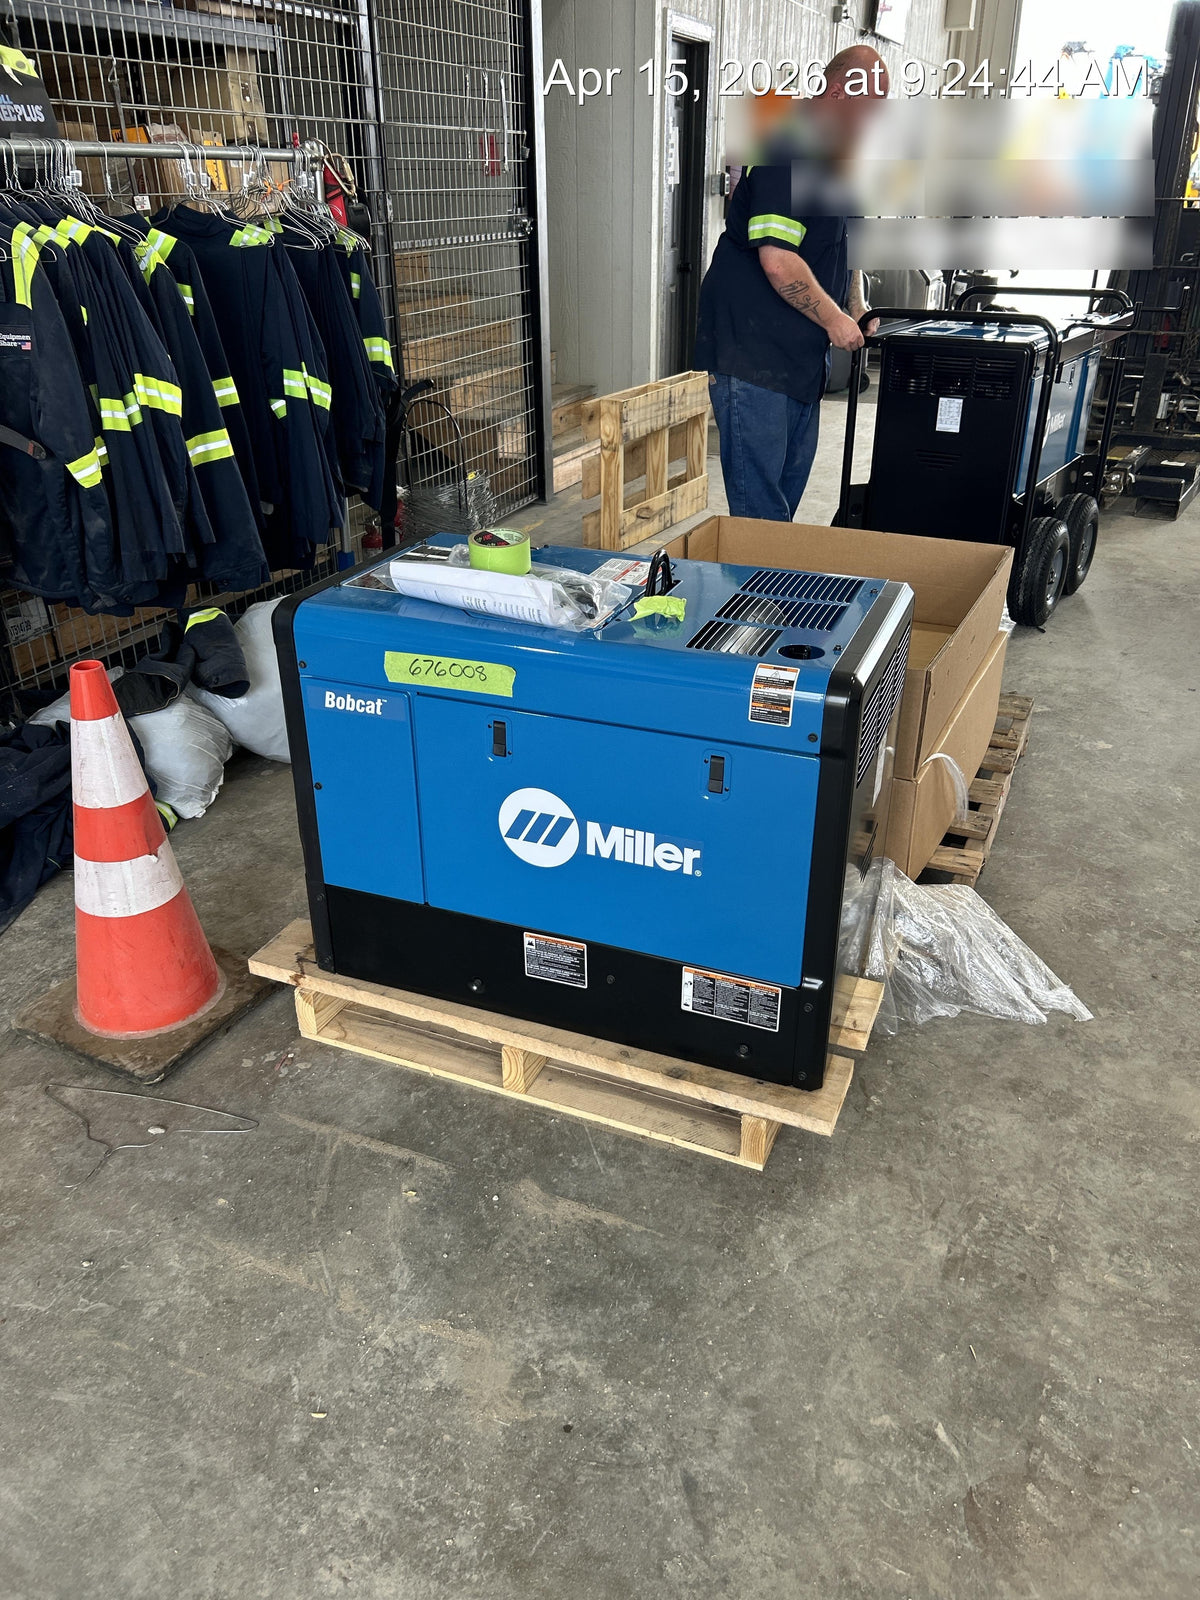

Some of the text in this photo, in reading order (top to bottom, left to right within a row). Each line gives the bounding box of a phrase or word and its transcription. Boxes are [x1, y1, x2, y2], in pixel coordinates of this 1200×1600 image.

[408, 658, 488, 682] 676008
[324, 690, 384, 716] Bobcat
[586, 820, 701, 876] Miller
